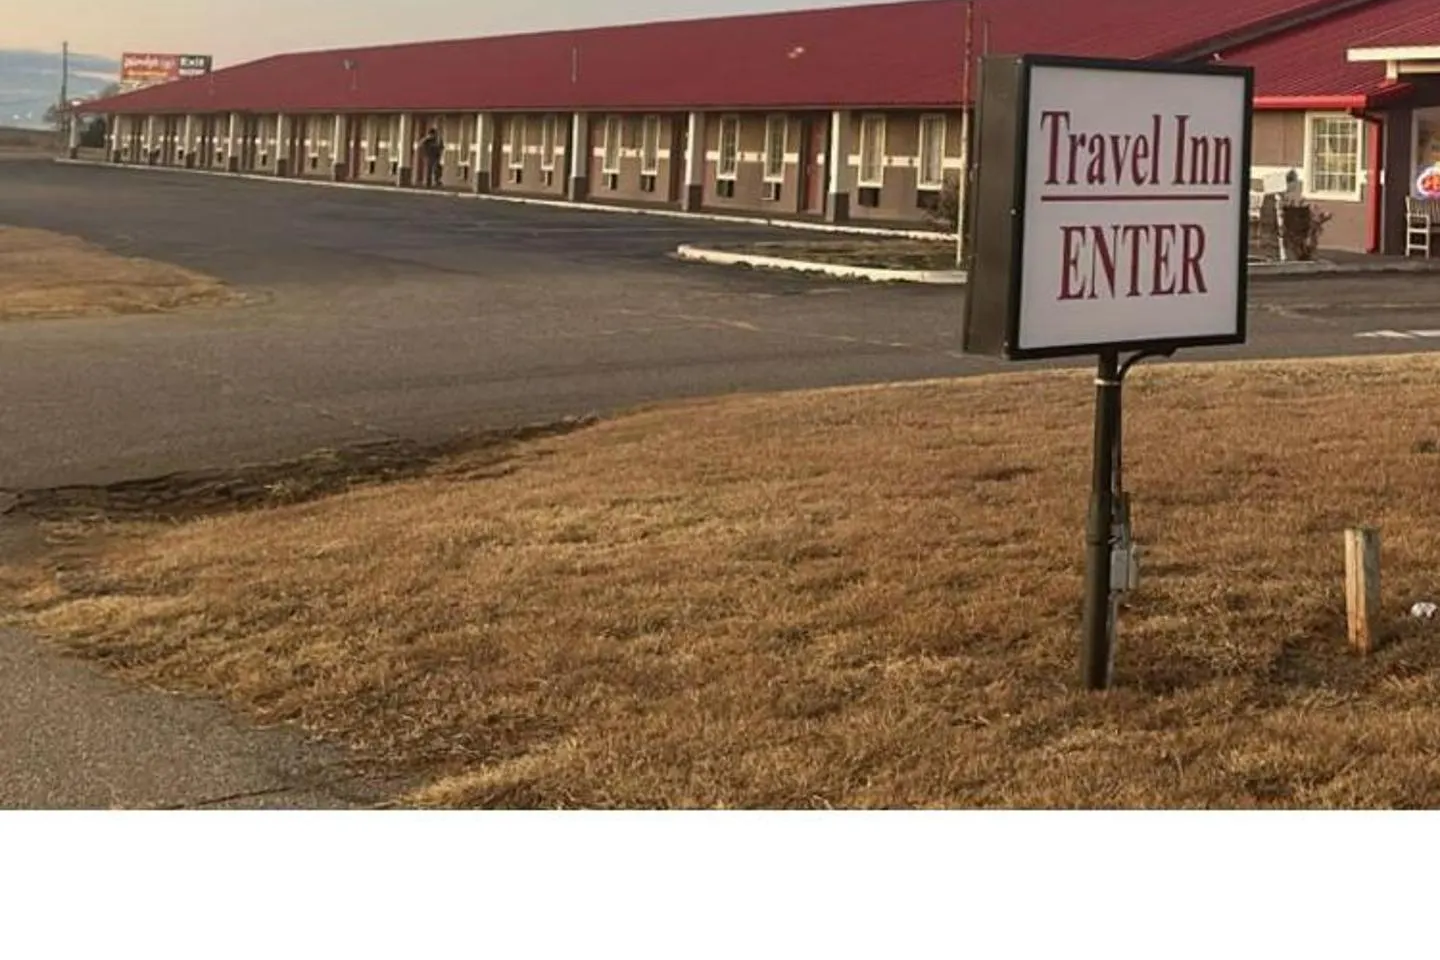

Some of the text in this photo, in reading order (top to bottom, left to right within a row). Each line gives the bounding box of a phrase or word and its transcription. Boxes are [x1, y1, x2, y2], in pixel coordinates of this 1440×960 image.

[1040, 111, 1232, 185] Travel Inn
[1057, 224, 1207, 300] ENTER
